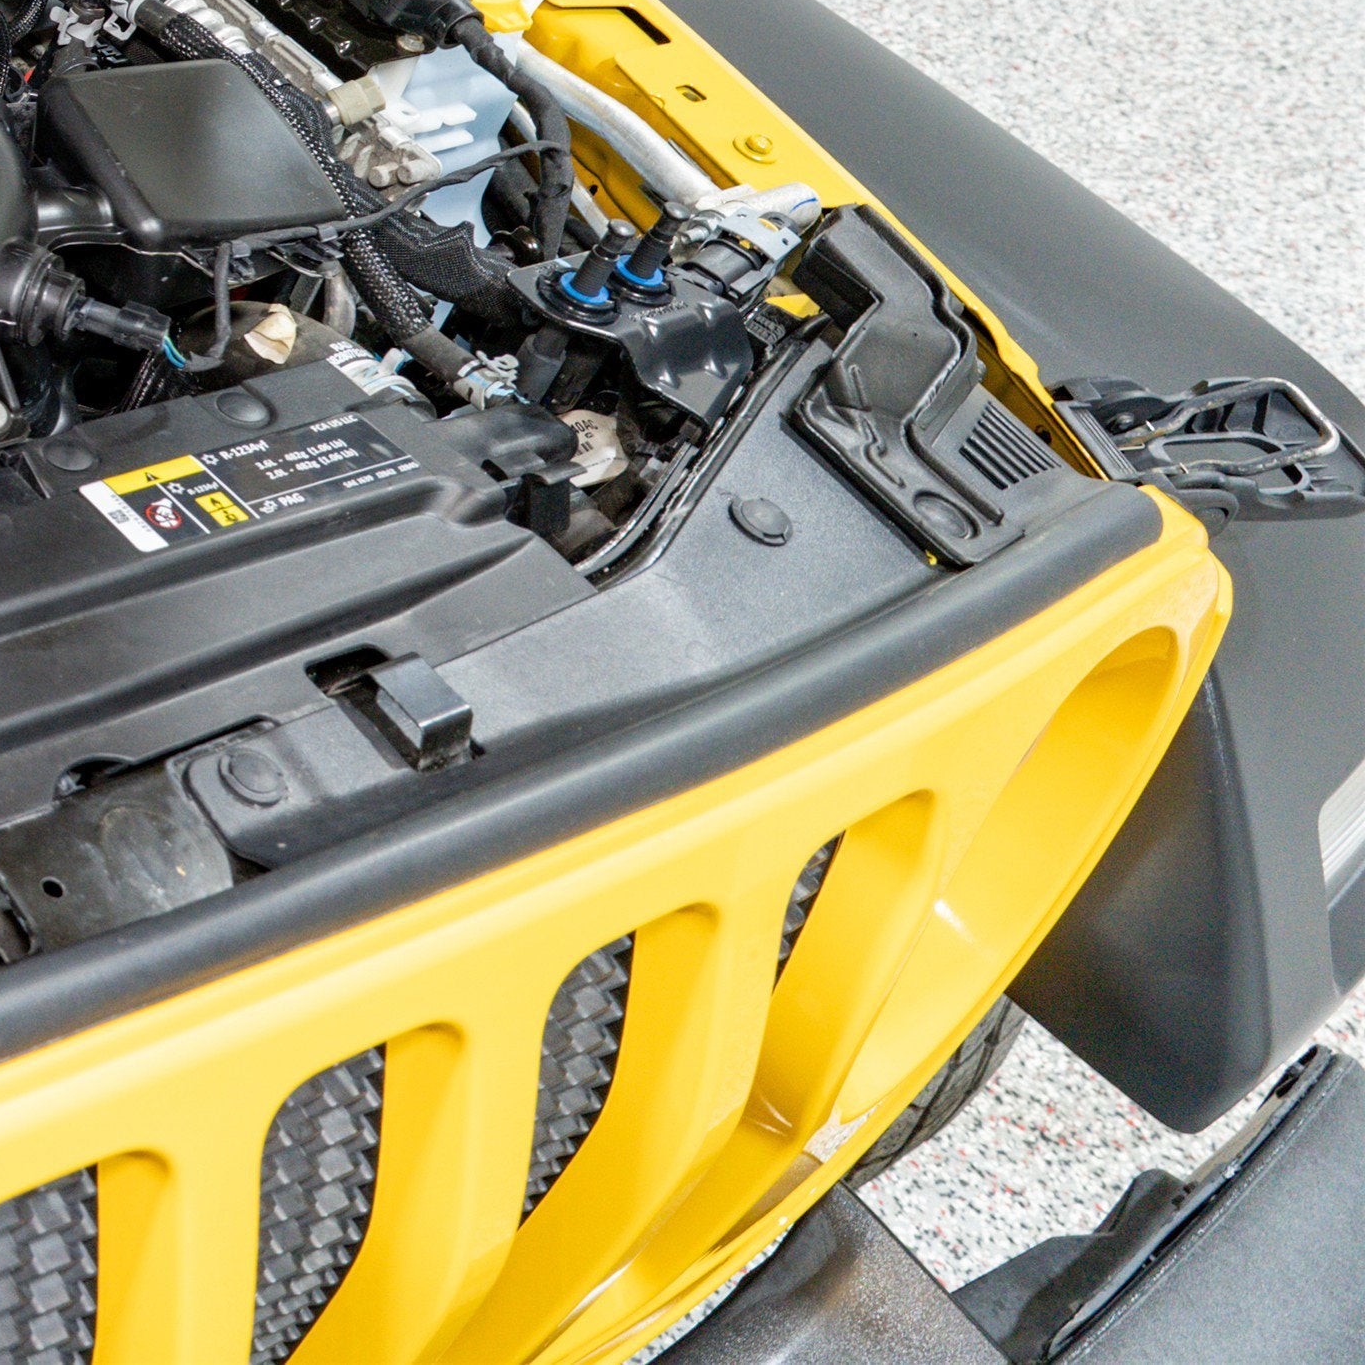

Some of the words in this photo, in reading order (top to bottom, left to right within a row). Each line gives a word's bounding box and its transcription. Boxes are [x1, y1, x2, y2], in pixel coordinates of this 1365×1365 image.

[310, 422, 329, 433] FCA
[327, 418, 342, 430] US
[340, 414, 359, 426] LLC
[219, 439, 270, 460] R-1234yf
[255, 457, 278, 470] 3.6L
[266, 467, 290, 481] 2.0L
[278, 491, 305, 507] PAG
